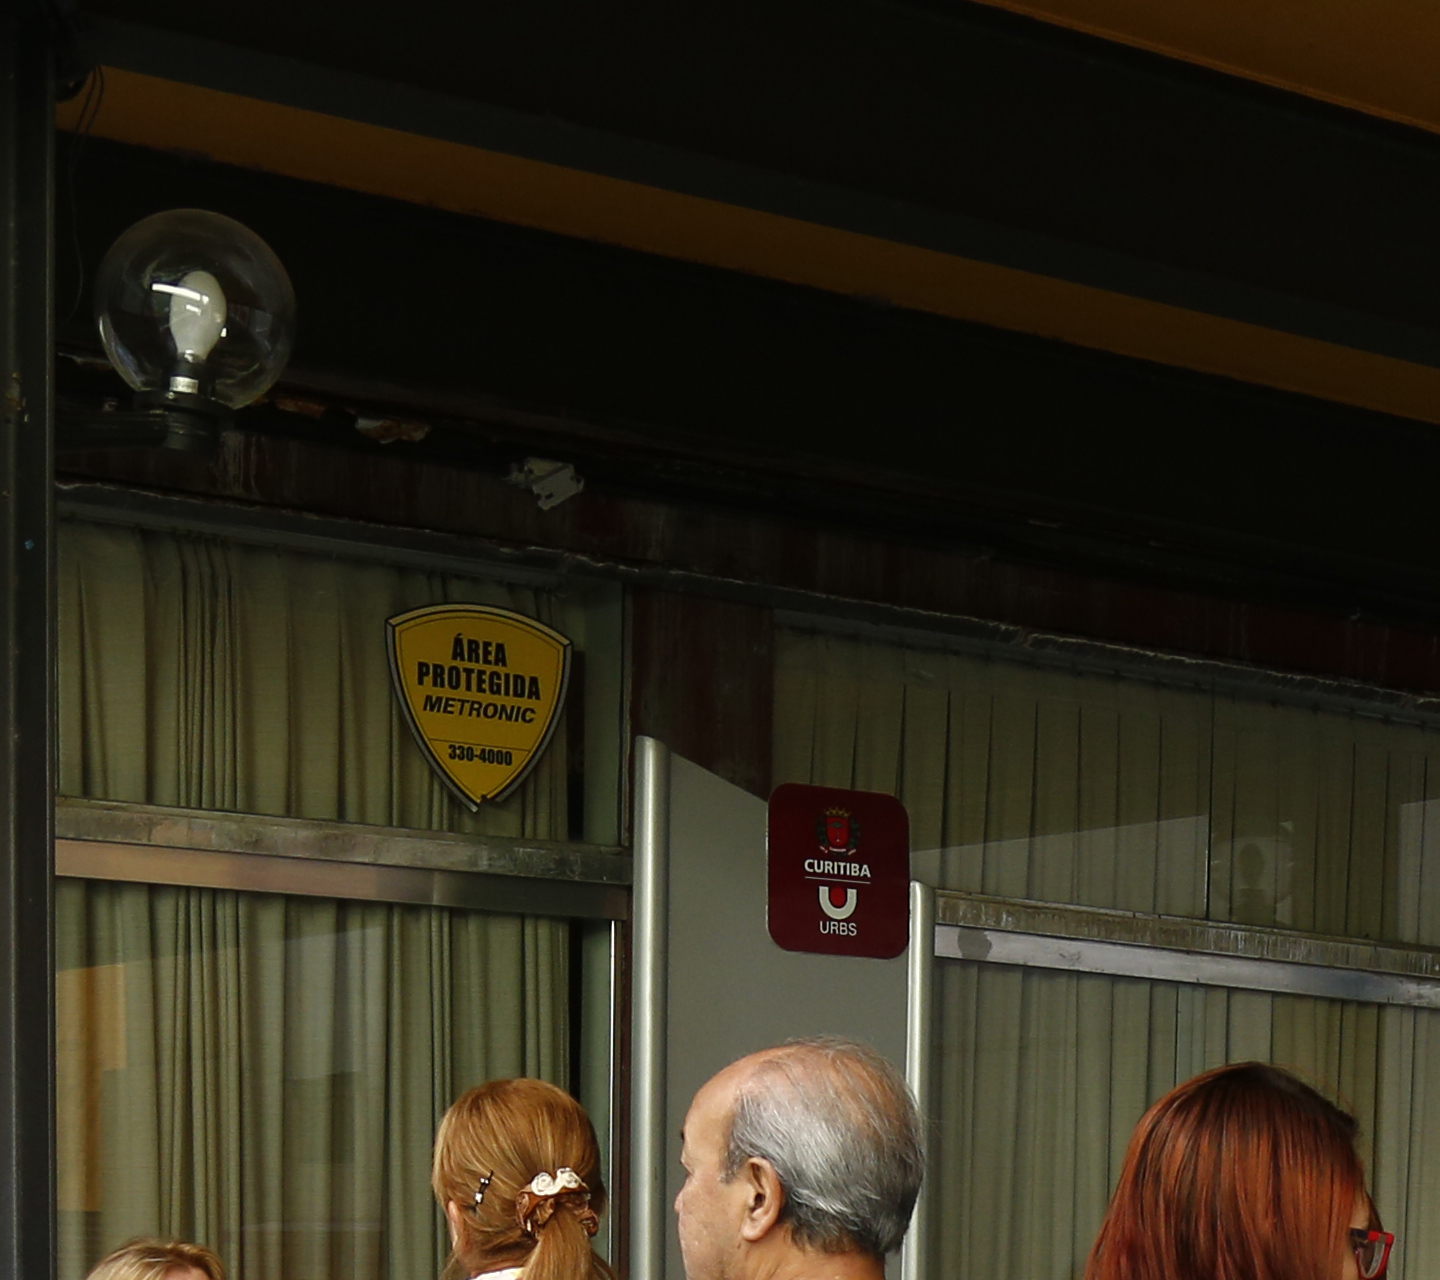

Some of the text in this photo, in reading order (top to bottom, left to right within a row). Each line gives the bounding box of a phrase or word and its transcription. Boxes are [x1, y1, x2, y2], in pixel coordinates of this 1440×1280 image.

[452, 632, 507, 667] ÁREA
[418, 661, 541, 700] PROTEGIDA
[423, 695, 536, 724] METRONIC
[449, 744, 512, 766] 330-4000
[805, 859, 871, 877] CURITIBA
[820, 921, 857, 936] URBS
